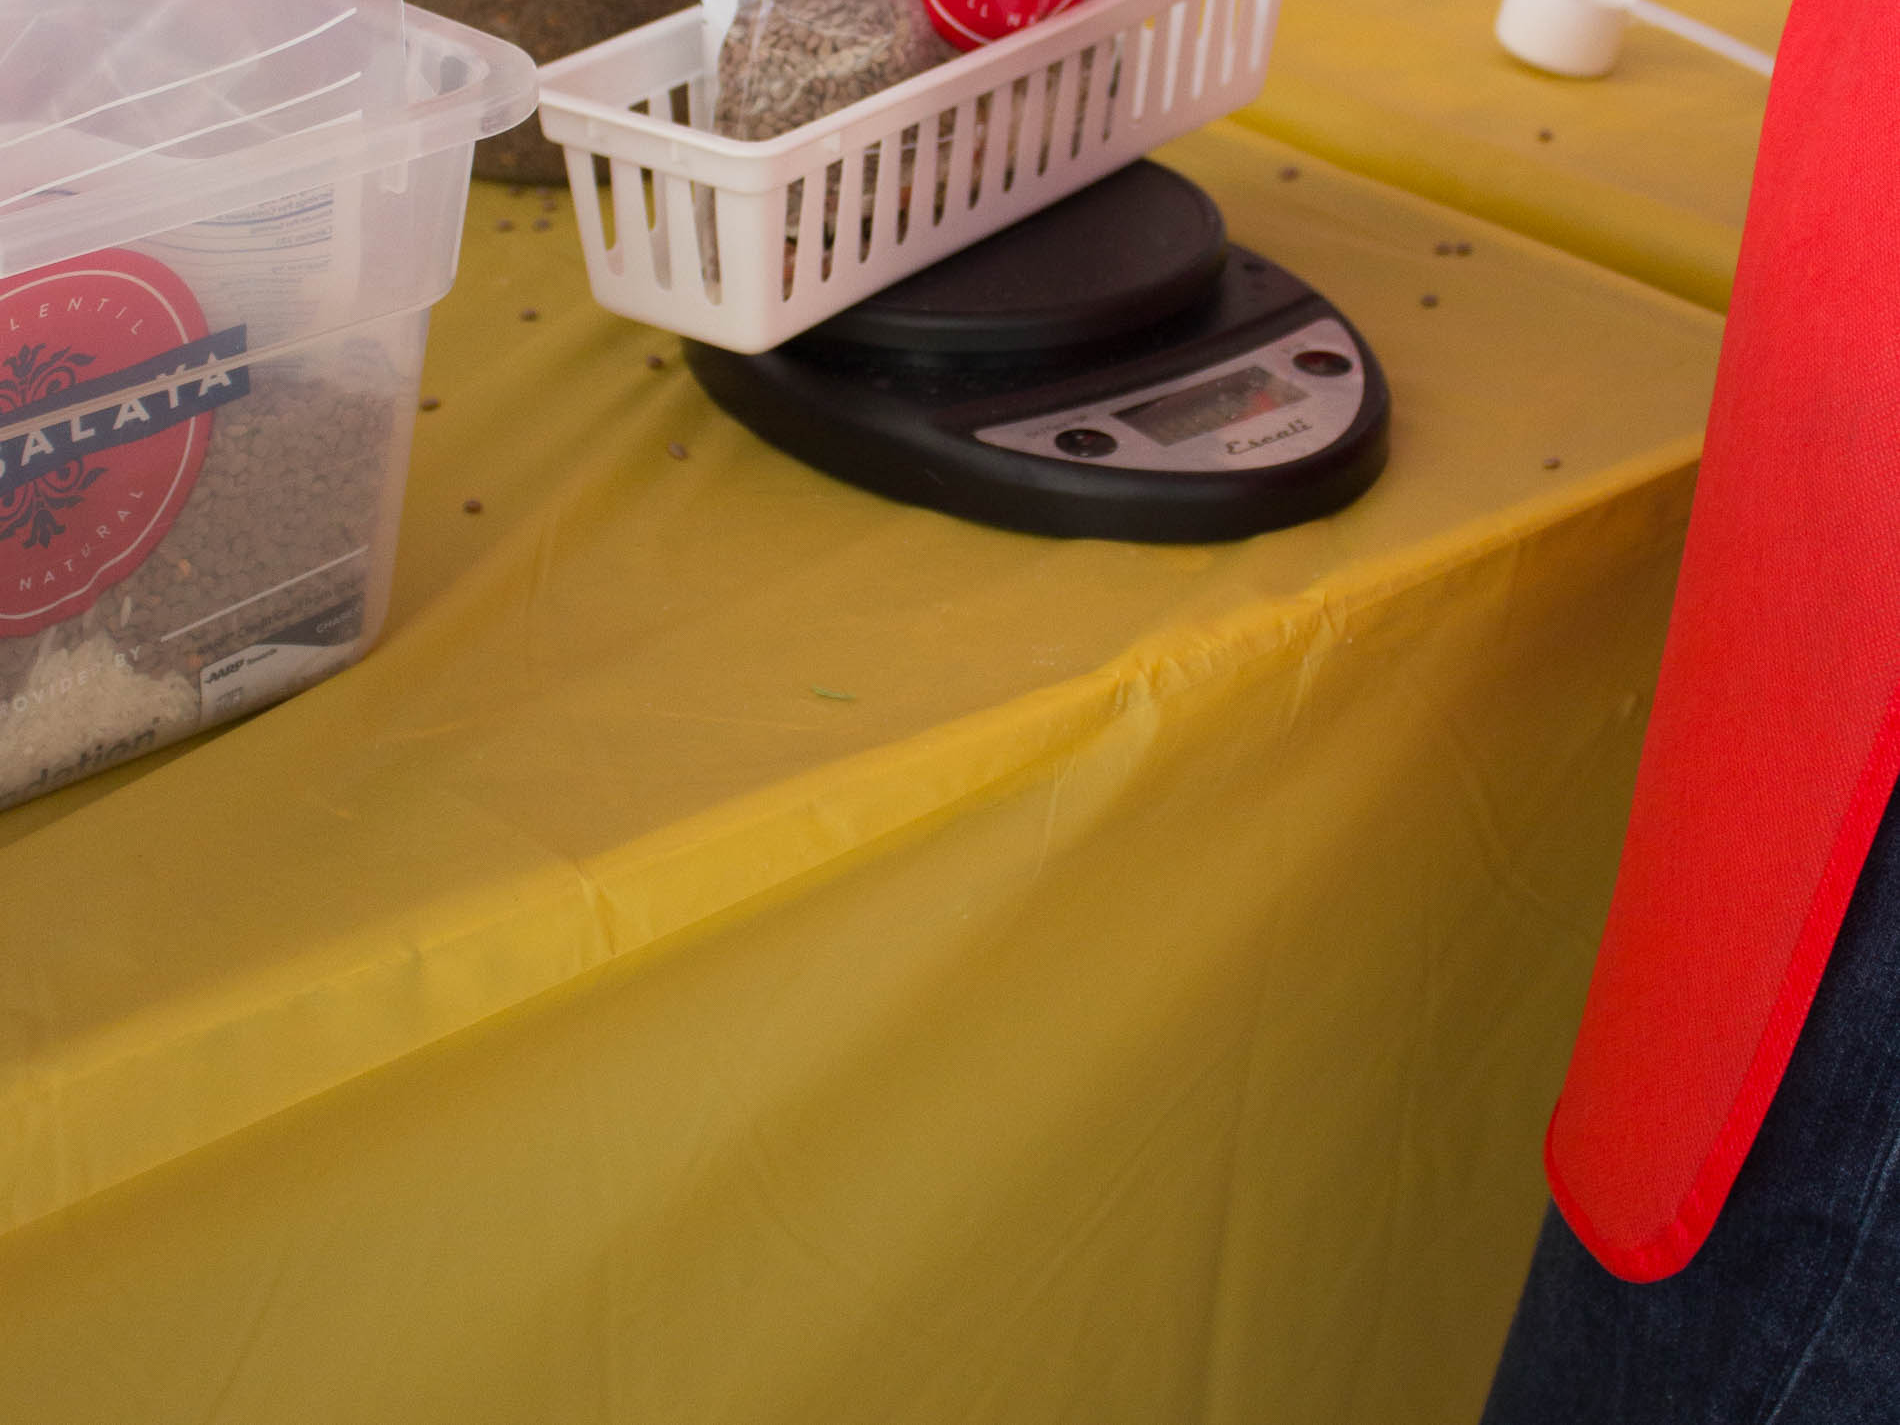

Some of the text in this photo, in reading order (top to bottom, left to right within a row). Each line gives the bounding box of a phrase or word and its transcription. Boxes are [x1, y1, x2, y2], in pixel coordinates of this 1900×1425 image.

[9, 295, 144, 336] LENTIL
[19, 489, 144, 591] NATURAL
[115, 644, 142, 668] BY
